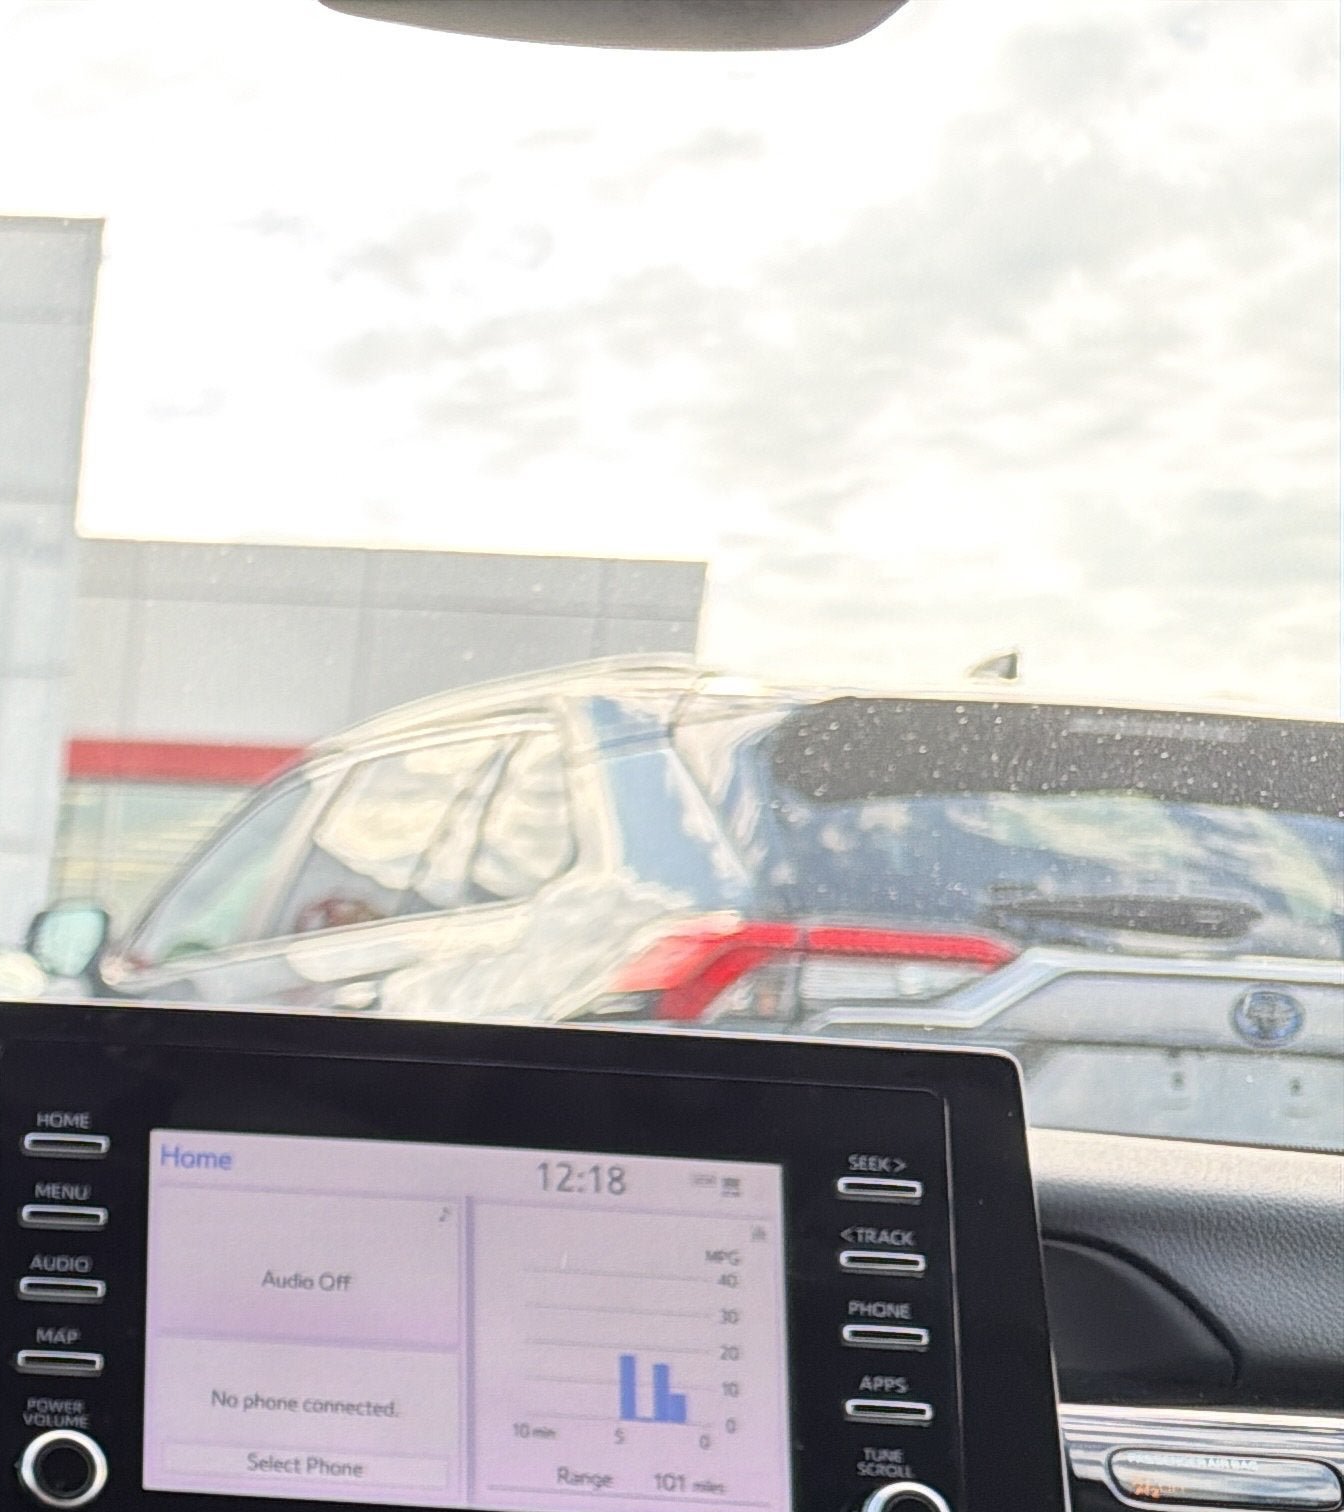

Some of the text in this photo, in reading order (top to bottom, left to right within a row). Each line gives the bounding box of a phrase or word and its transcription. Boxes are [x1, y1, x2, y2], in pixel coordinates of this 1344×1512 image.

[36, 1111, 91, 1129] HOME
[160, 1143, 233, 1170] Home
[537, 1162, 627, 1195] 12:18
[35, 1181, 91, 1201] MENU
[29, 1254, 93, 1273] AUDIO
[261, 1269, 352, 1292] Audio Off
[848, 1300, 912, 1320] PHONE
[36, 1327, 81, 1344] MAP
[720, 1345, 739, 1361] 20
[722, 1381, 739, 1398] 10
[859, 1375, 909, 1394] APPS
[26, 1397, 85, 1414] POWER
[210, 1389, 399, 1418] No phone connected.
[22, 1413, 89, 1429] VOLUME
[725, 1417, 736, 1434] 0
[513, 1423, 530, 1438] 10
[699, 1434, 711, 1450] 0
[863, 1447, 904, 1463] TUNE
[246, 1452, 365, 1478] Select Phone
[856, 1461, 916, 1478] SCROLL
[557, 1466, 614, 1489] Range
[654, 1473, 686, 1492] 101
